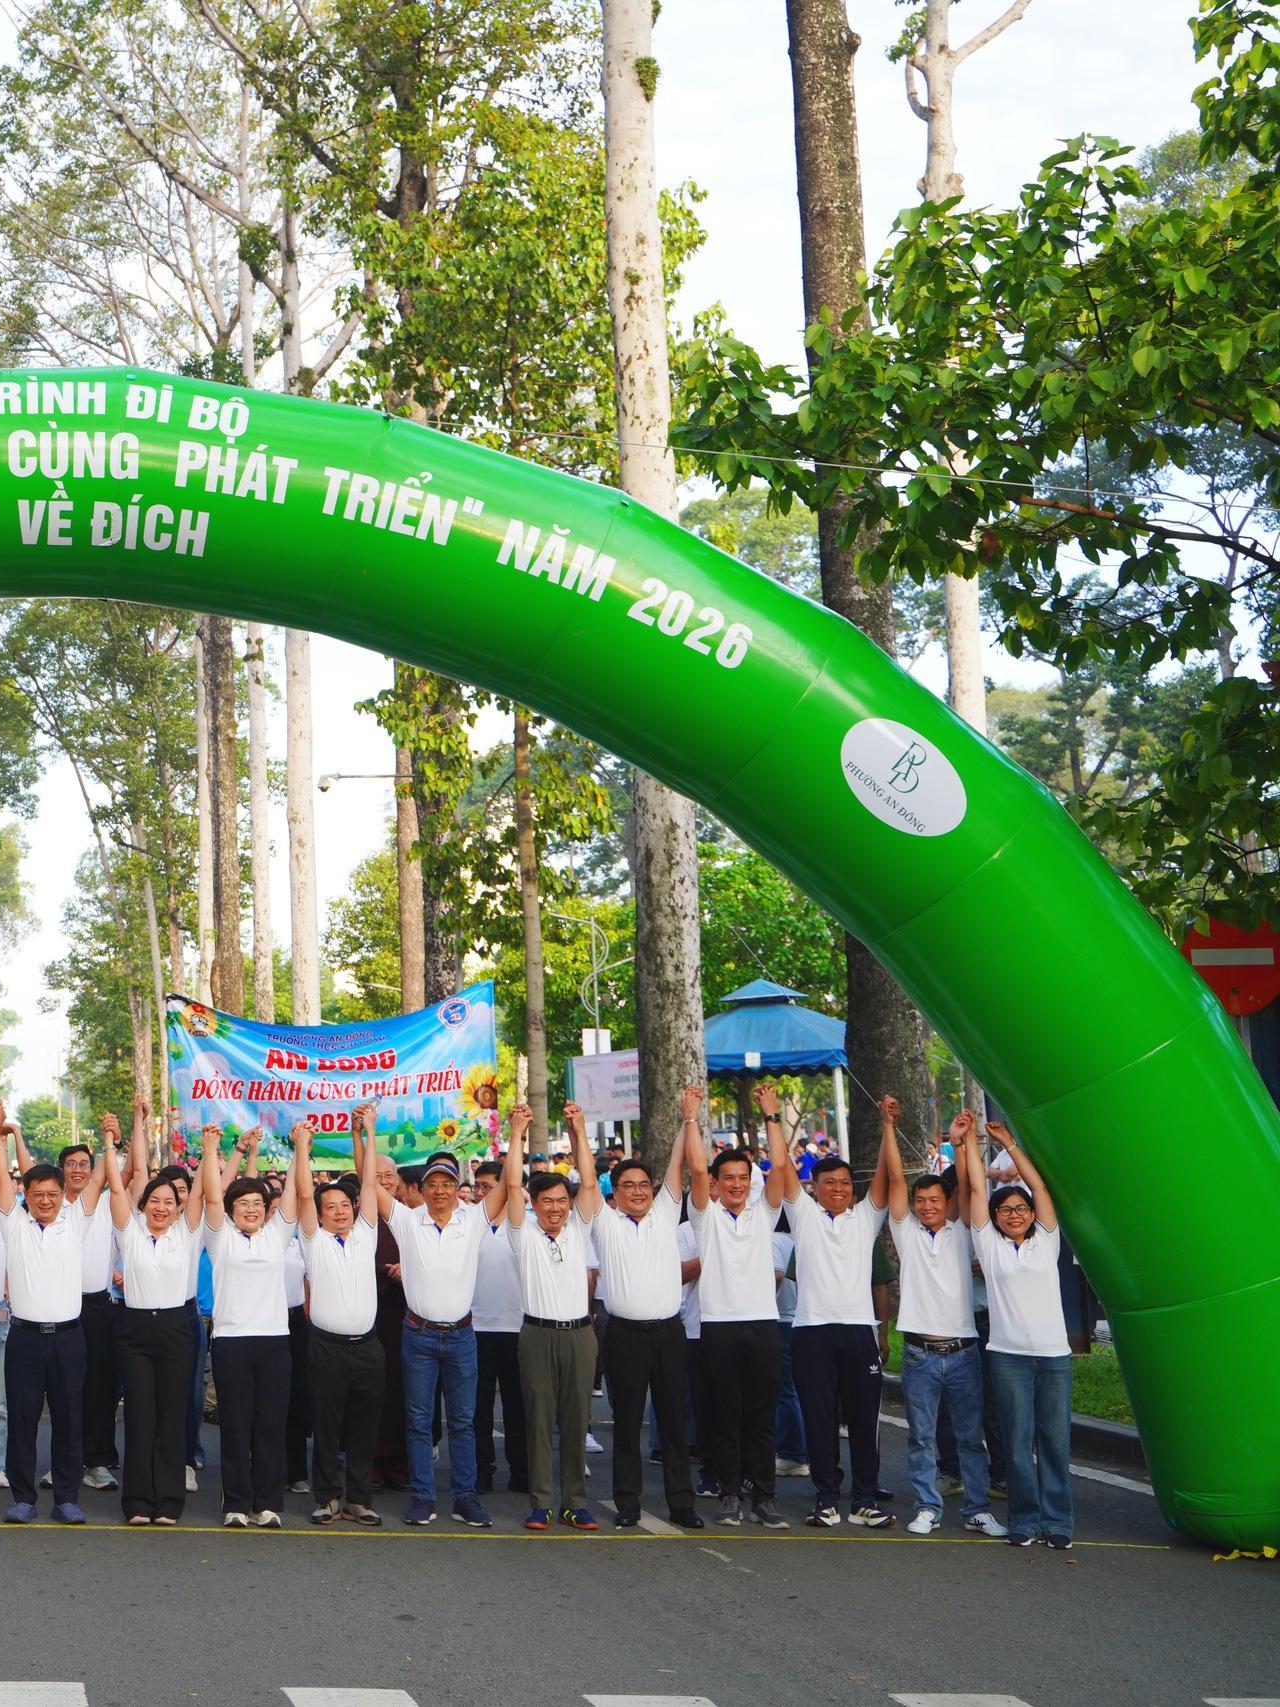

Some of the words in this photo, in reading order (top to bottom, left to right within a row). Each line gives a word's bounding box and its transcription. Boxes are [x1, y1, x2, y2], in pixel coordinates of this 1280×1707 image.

[187, 394, 250, 445] BỘ
[17, 481, 74, 546] VỀ
[91, 494, 210, 557] ĐÍCH
[7, 421, 139, 480] CÙNG
[175, 441, 299, 504] PHÁT
[496, 519, 616, 602] NĂM
[627, 577, 753, 670] 2026
[845, 761, 885, 798] PHƯỜNG
[883, 795, 900, 809] AN
[897, 807, 926, 833] ĐÔNG
[191, 1070, 245, 1100] ĐỒNG
[248, 1076, 302, 1101] HÀNH
[306, 1077, 357, 1100] CÙNG
[361, 1073, 412, 1098] PHÁT
[416, 1060, 464, 1094] TRIỂN
[265, 1048, 308, 1070] AN
[306, 1112, 349, 1133] 202
